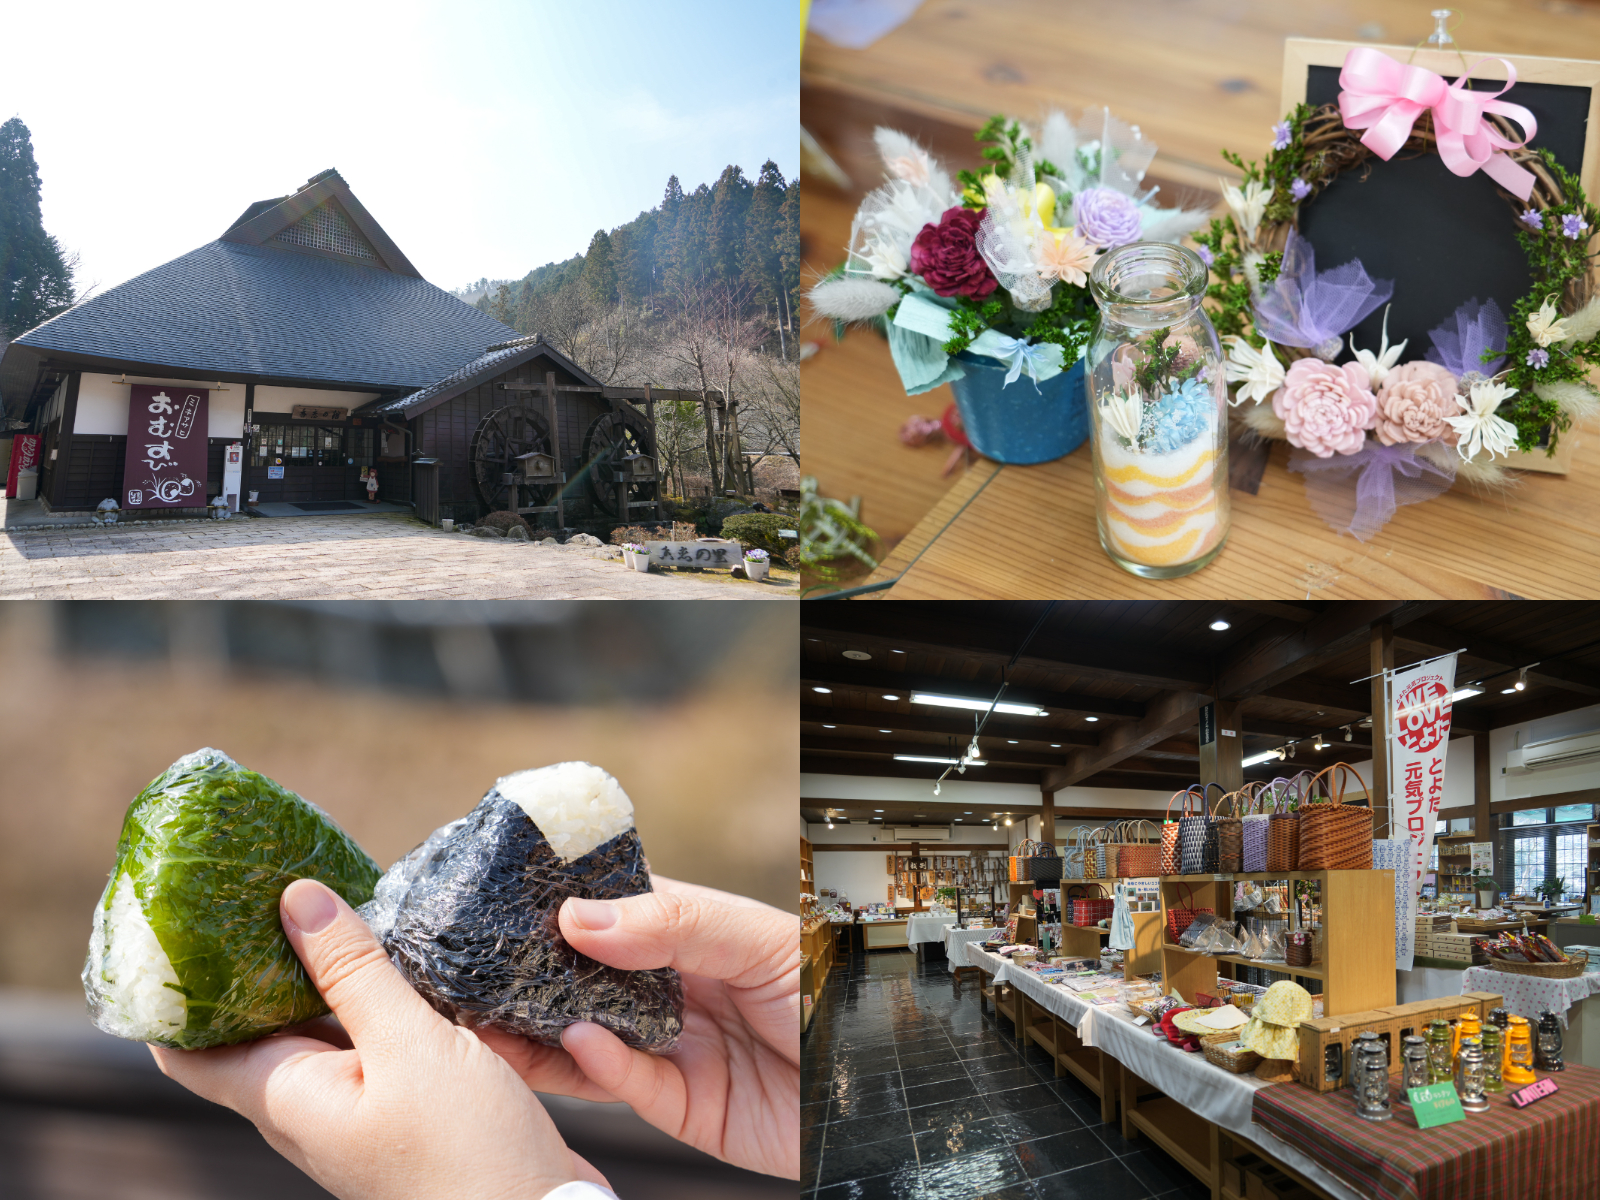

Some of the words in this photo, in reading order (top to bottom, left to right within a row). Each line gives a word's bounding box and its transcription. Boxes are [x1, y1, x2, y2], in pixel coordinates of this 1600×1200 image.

[141, 391, 181, 471] おむすび
[179, 397, 196, 436] ミネアサヒ
[1395, 695, 1452, 736] LOVE
[1402, 682, 1440, 711] WE
[1403, 719, 1450, 752] とよた
[1429, 757, 1443, 813] とよた
